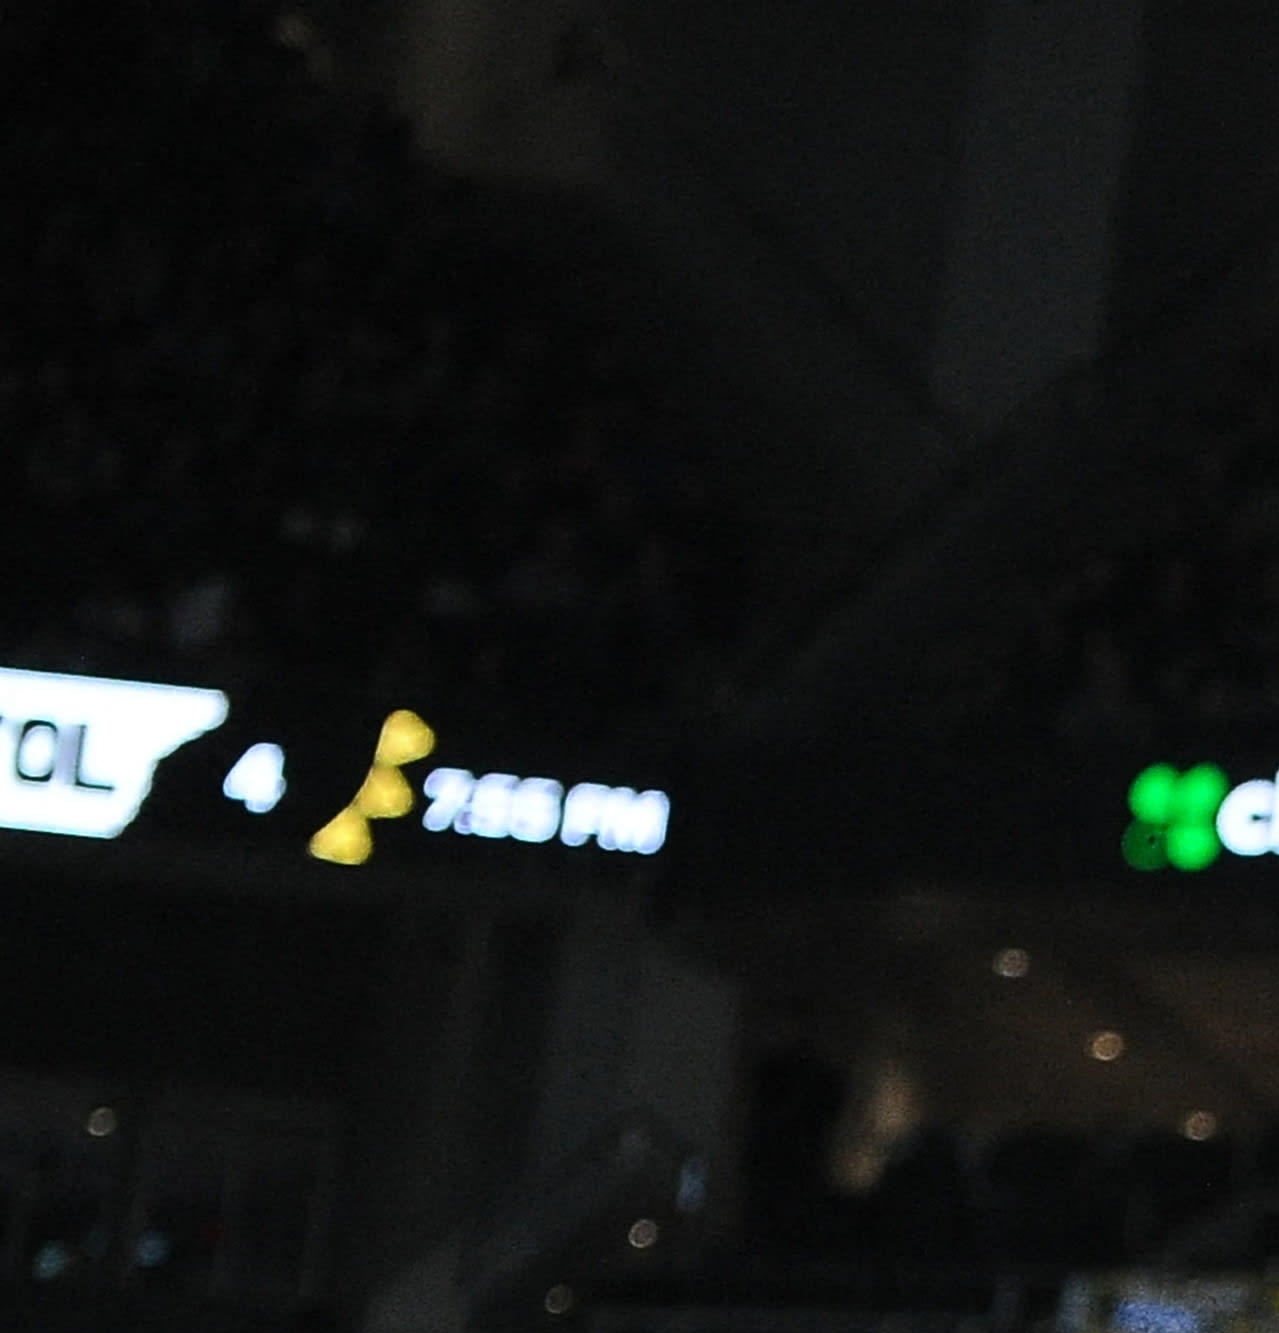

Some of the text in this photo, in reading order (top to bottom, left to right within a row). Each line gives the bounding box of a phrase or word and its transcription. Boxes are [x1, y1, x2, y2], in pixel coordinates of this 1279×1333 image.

[0, 716, 115, 790] OL
[223, 743, 286, 813] 4
[560, 782, 670, 854] PM
